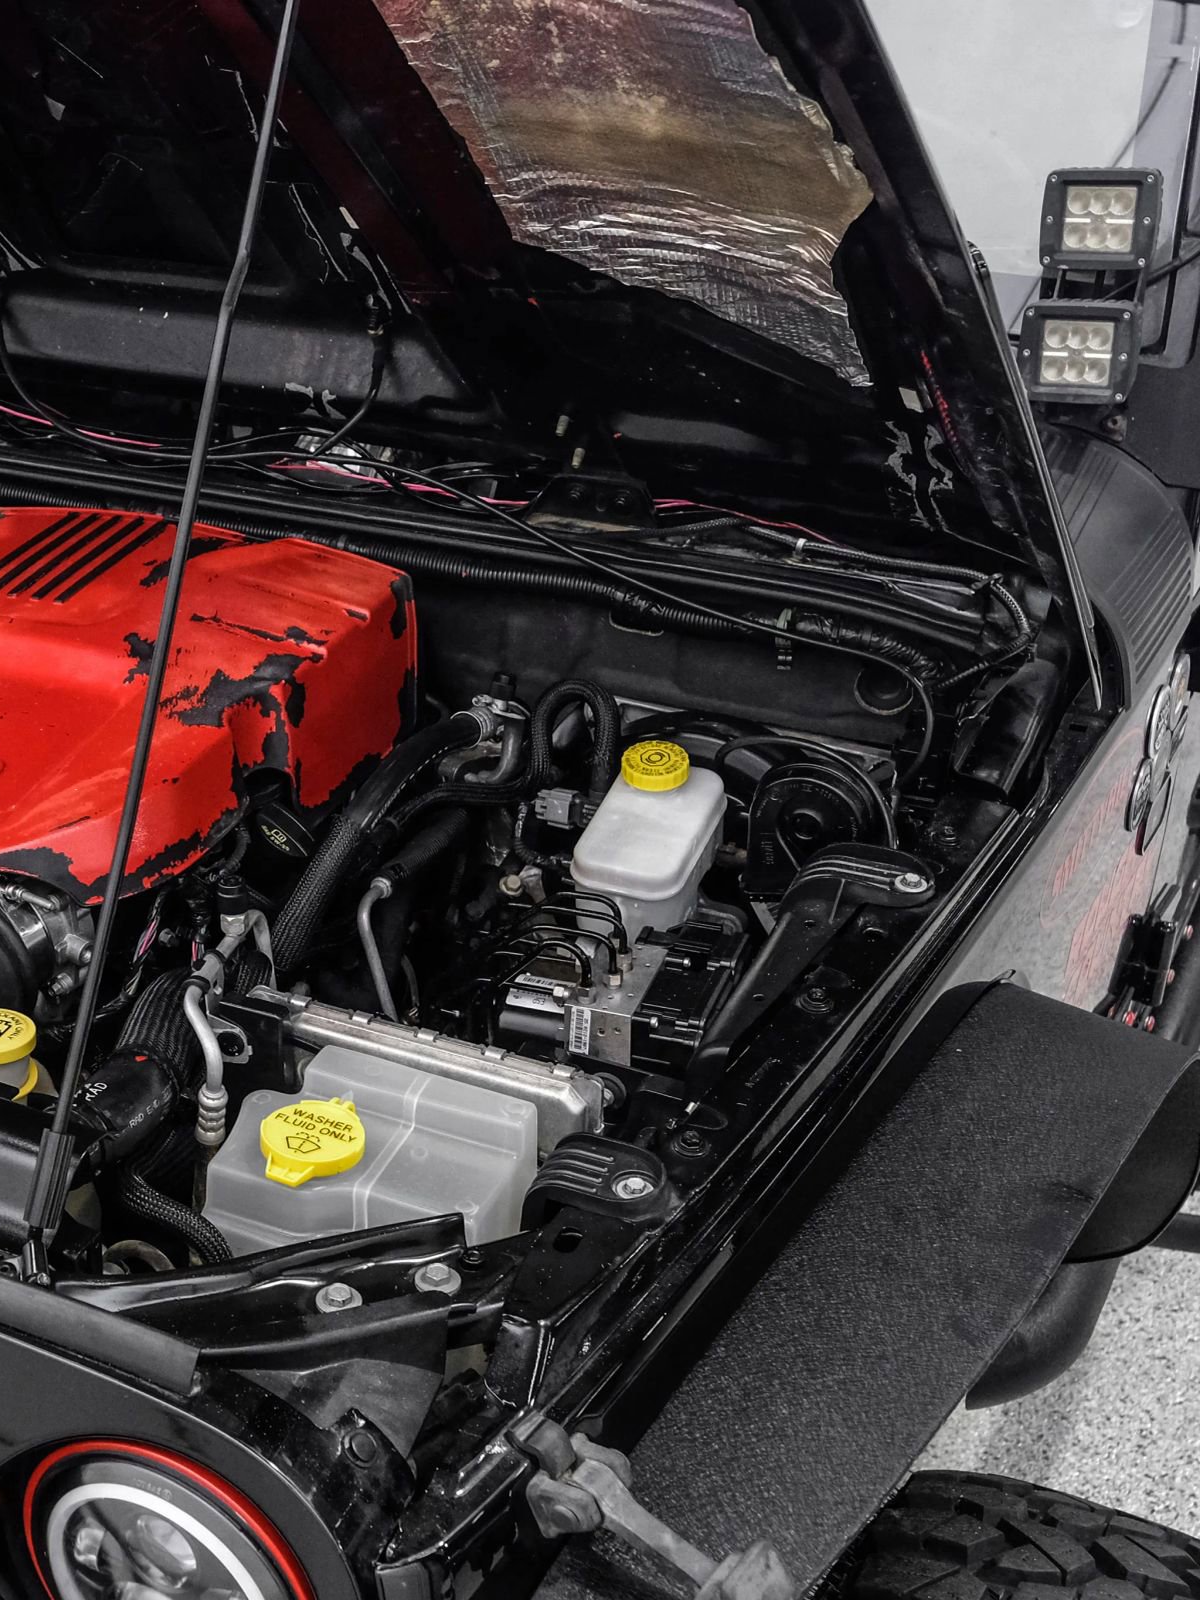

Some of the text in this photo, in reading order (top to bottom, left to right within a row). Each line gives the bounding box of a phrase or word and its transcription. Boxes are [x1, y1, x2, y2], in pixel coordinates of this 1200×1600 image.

[7, 1025, 25, 1041] ONLY
[274, 1112, 358, 1144] FLUID ONLY
[293, 1107, 354, 1133] WASHER
